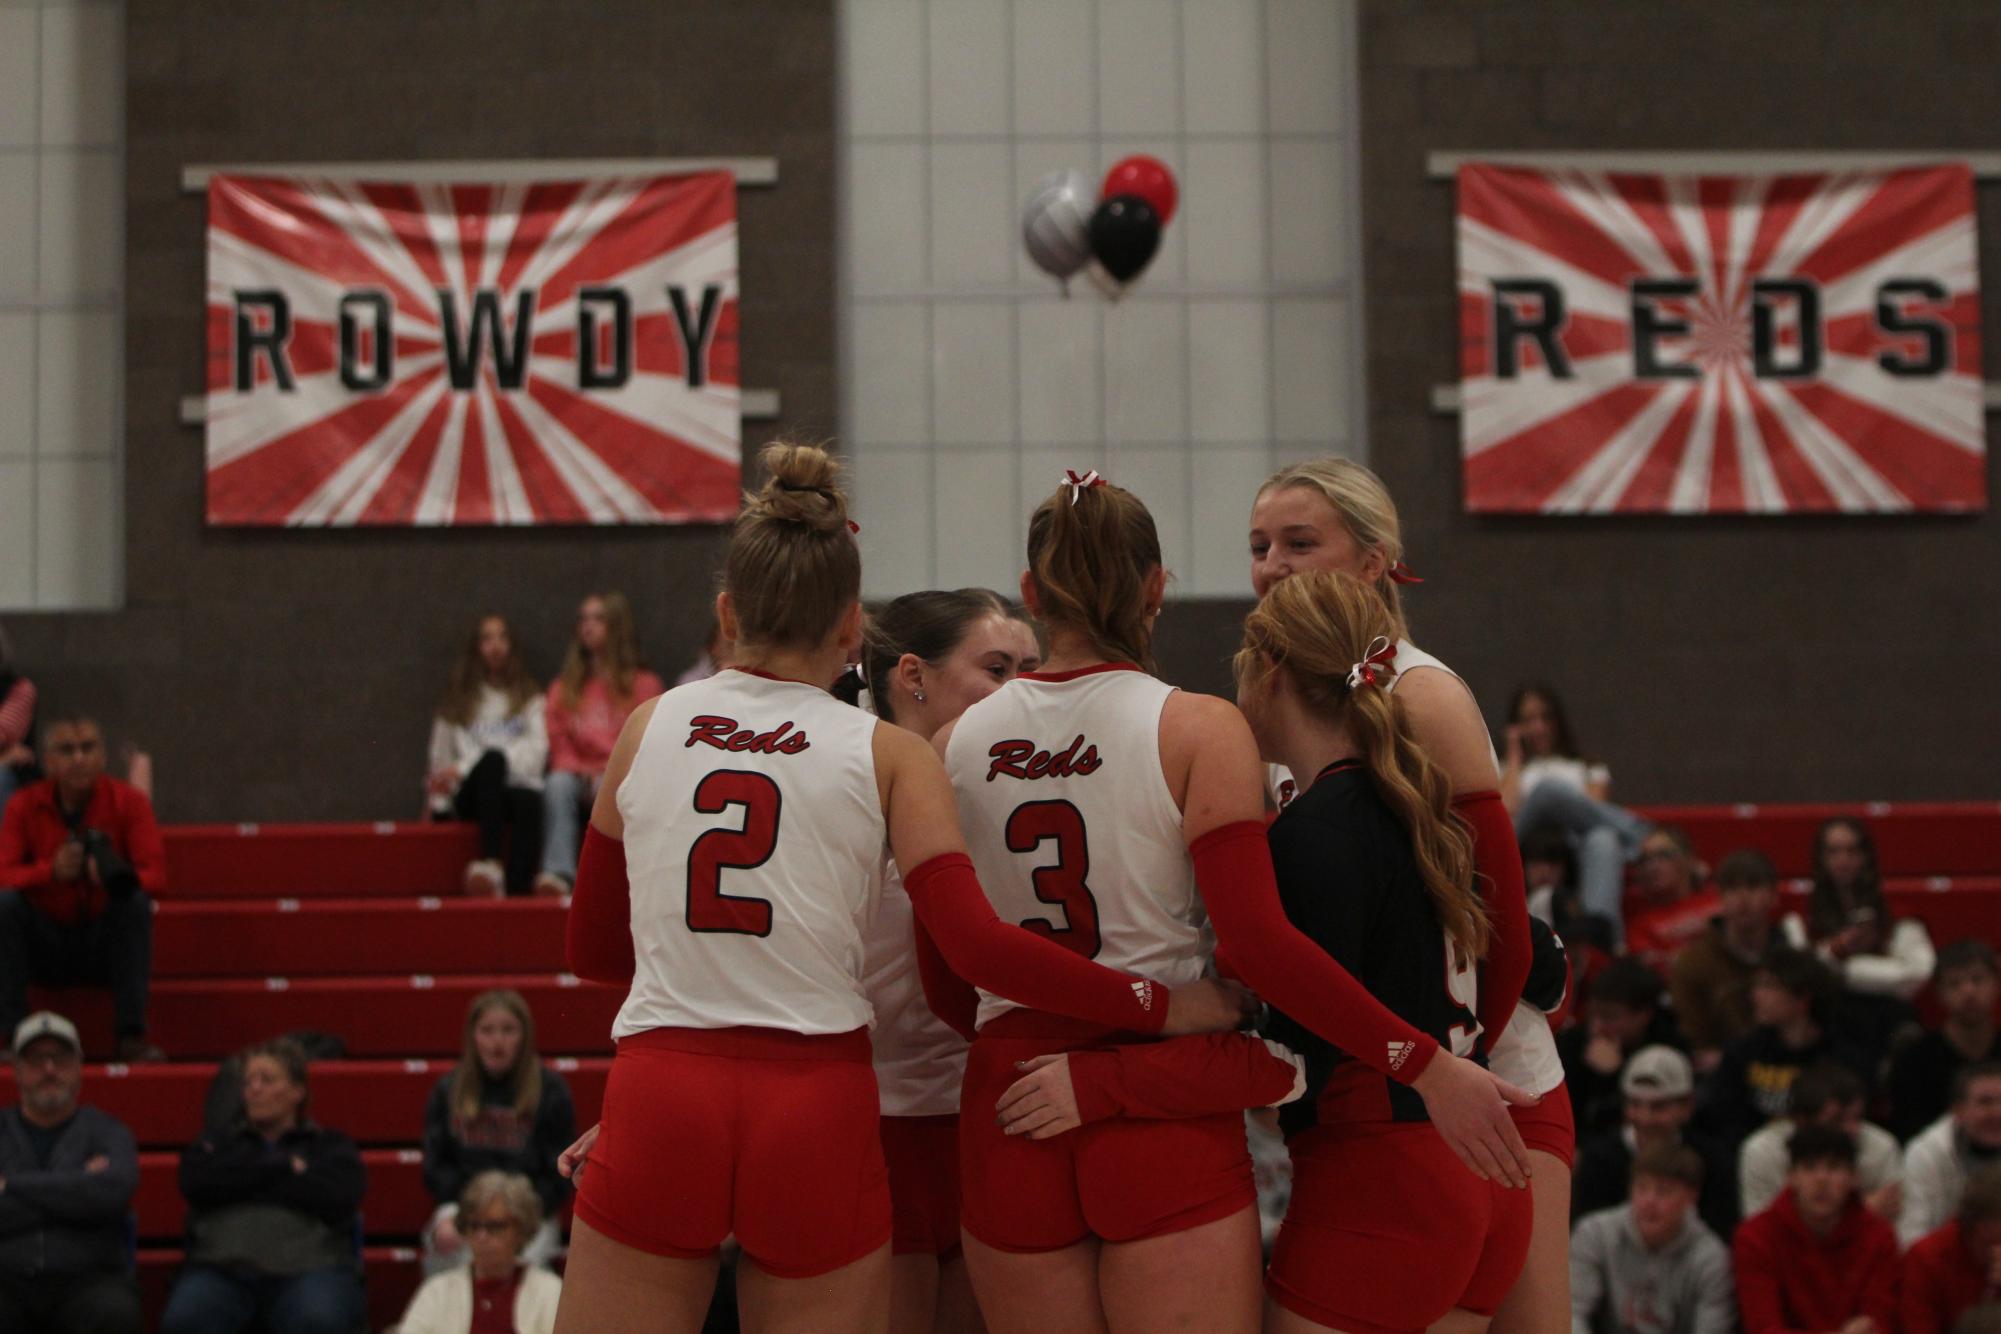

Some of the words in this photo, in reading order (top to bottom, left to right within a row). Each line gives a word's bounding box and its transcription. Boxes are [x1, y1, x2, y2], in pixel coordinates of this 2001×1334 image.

[232, 284, 722, 393] ROWDY
[1489, 277, 1950, 379] REDS
[685, 715, 810, 754] Reds
[986, 734, 1102, 782] Reds
[686, 769, 782, 937] 2
[1005, 799, 1102, 961] 3
[1391, 1040, 1416, 1071] adidas
